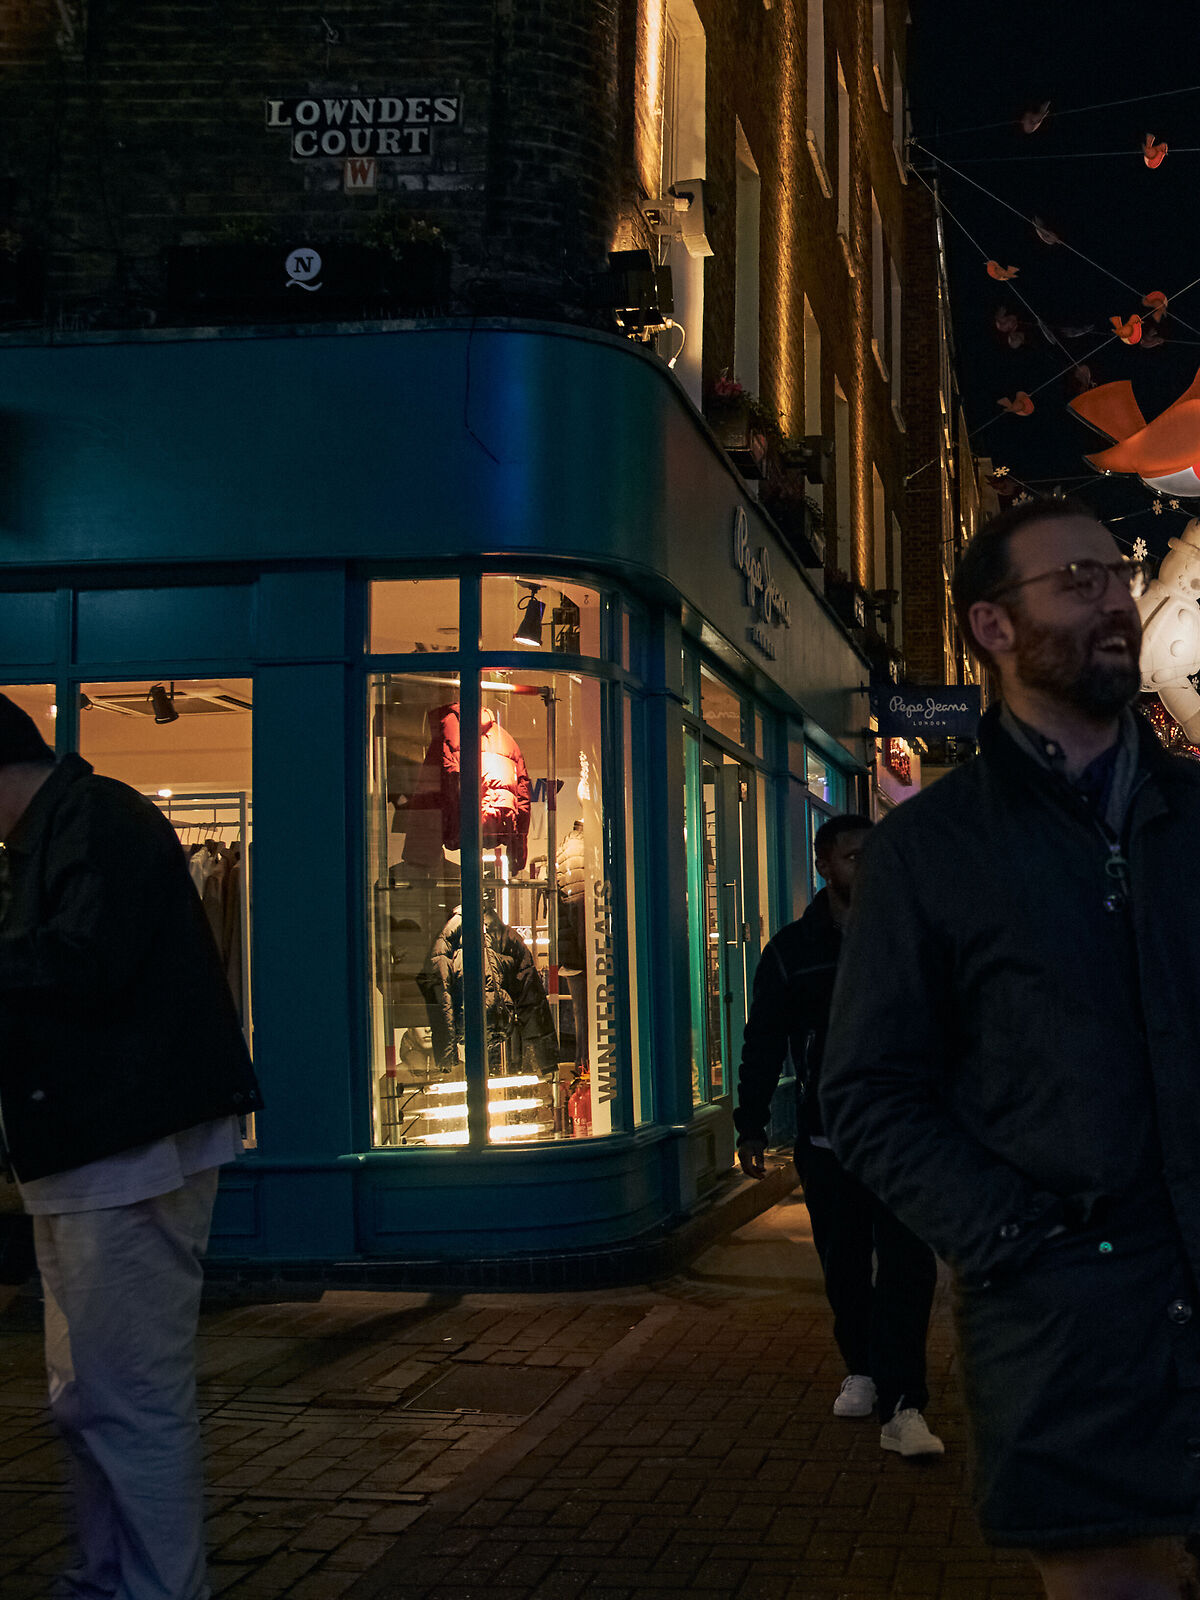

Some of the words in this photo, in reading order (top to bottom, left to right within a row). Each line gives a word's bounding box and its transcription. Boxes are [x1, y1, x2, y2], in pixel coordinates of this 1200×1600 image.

[267, 97, 457, 126] LOWNDES
[294, 126, 429, 156] COURT
[350, 159, 376, 185] W
[889, 695, 924, 719] Pepe
[924, 697, 969, 719] Jeans
[594, 879, 614, 977] BEATS
[597, 982, 617, 1105] WINTER
